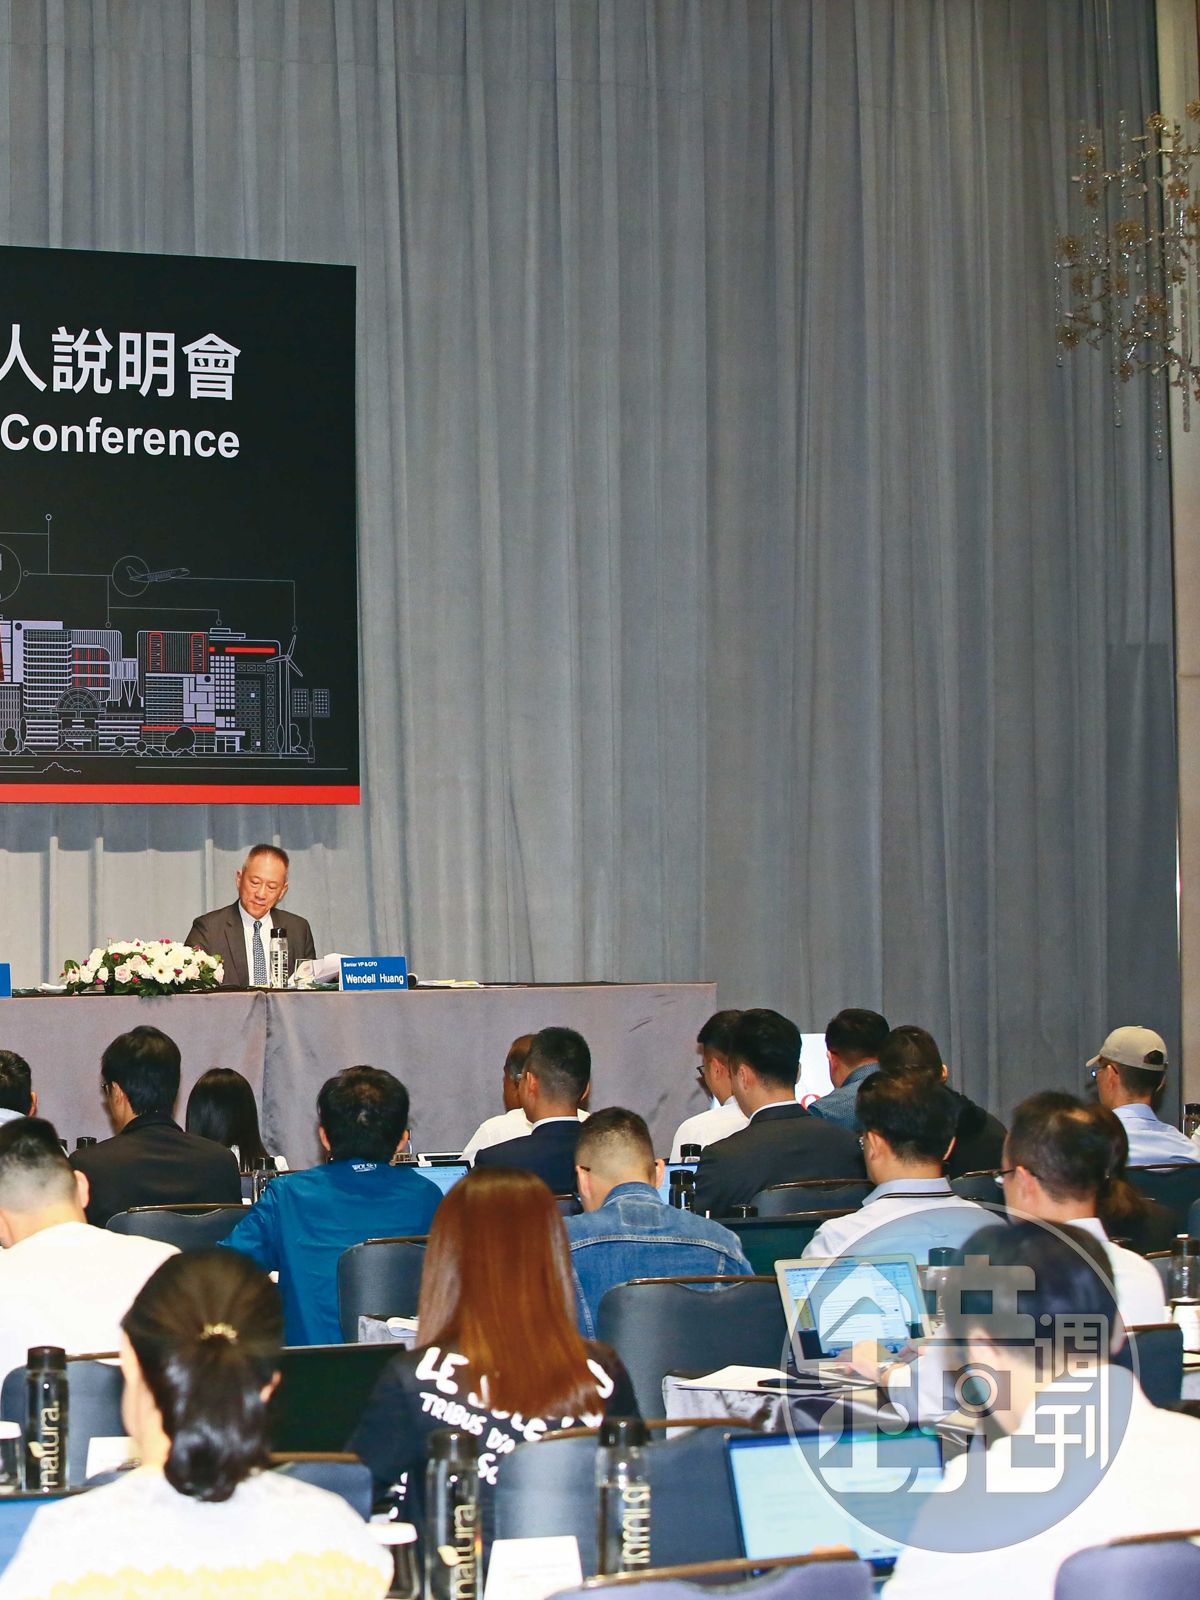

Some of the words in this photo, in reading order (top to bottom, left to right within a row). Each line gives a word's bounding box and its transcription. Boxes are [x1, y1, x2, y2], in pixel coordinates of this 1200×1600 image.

[1, 414, 240, 458] Conference
[345, 973, 377, 984] Wendell
[379, 973, 404, 985] Huang
